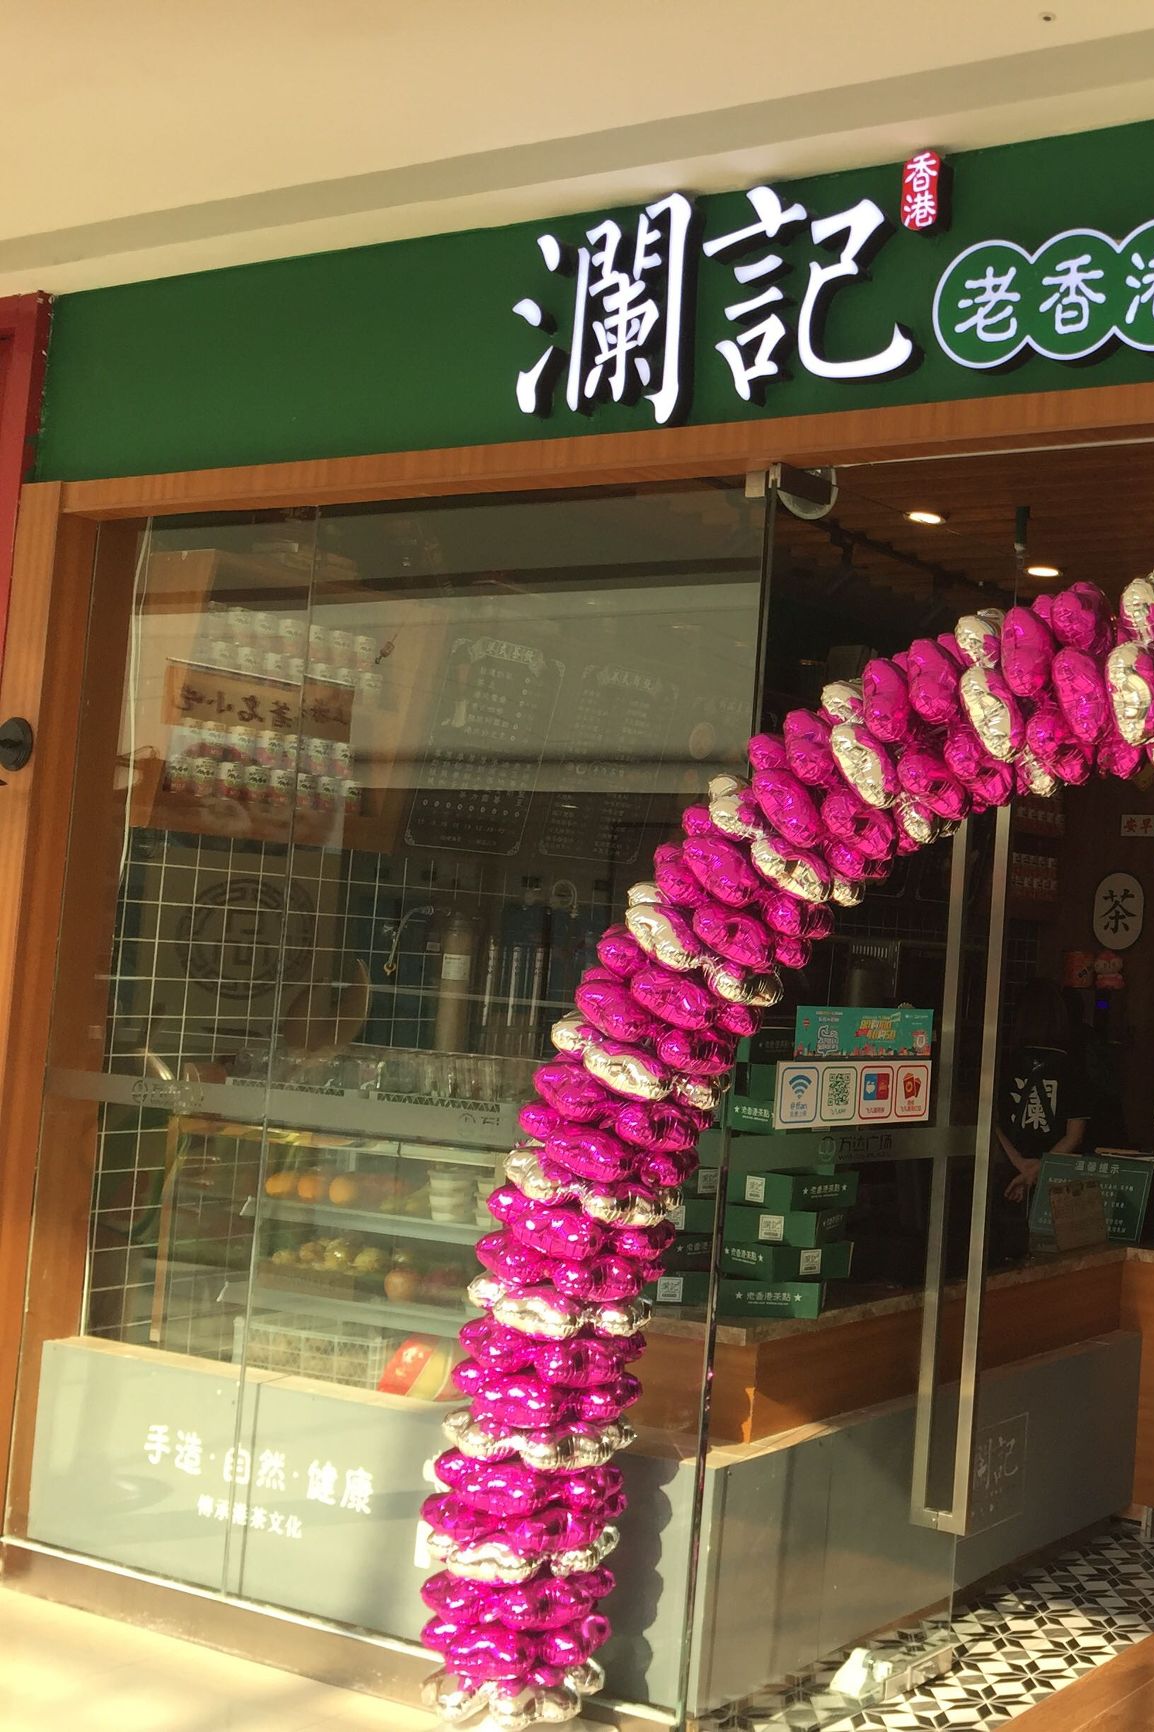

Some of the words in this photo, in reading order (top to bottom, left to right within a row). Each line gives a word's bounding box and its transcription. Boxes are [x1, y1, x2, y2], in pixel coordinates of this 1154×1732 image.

[904, 152, 938, 227] 香港
[513, 186, 911, 425] 瀾記
[1100, 888, 1137, 935] 茶
